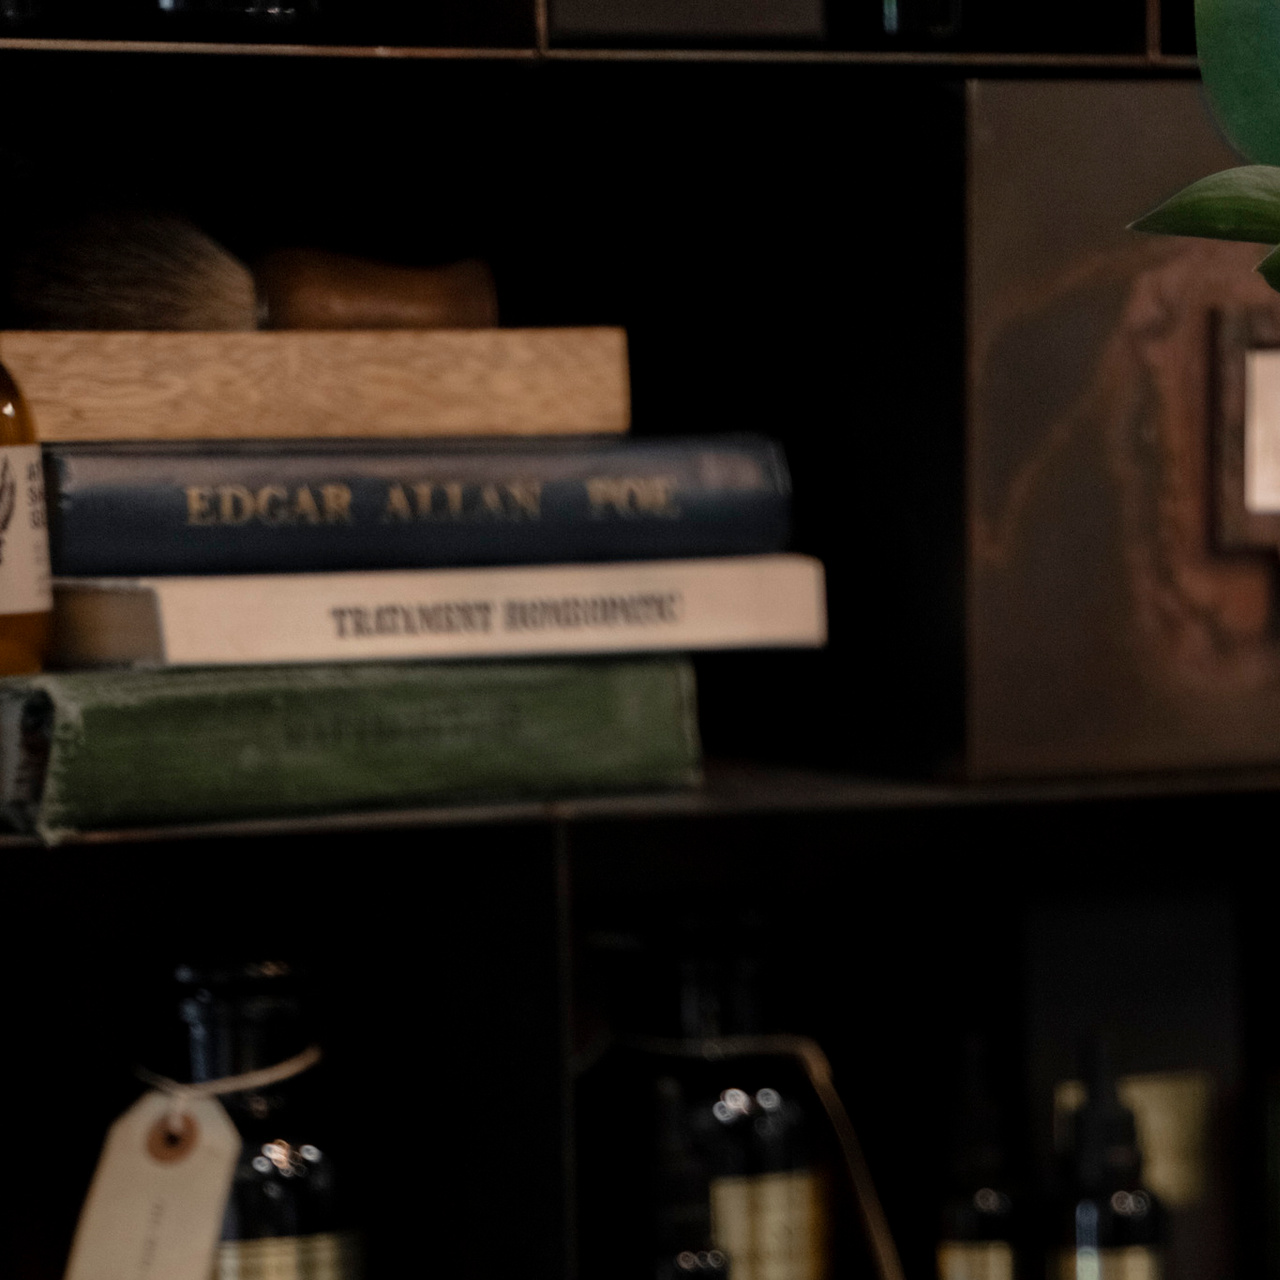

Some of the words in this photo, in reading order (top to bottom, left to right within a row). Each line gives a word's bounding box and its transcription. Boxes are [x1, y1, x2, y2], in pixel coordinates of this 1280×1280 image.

[185, 483, 353, 526] EDGAR
[382, 478, 543, 524] ALLAN
[584, 474, 681, 520] POE
